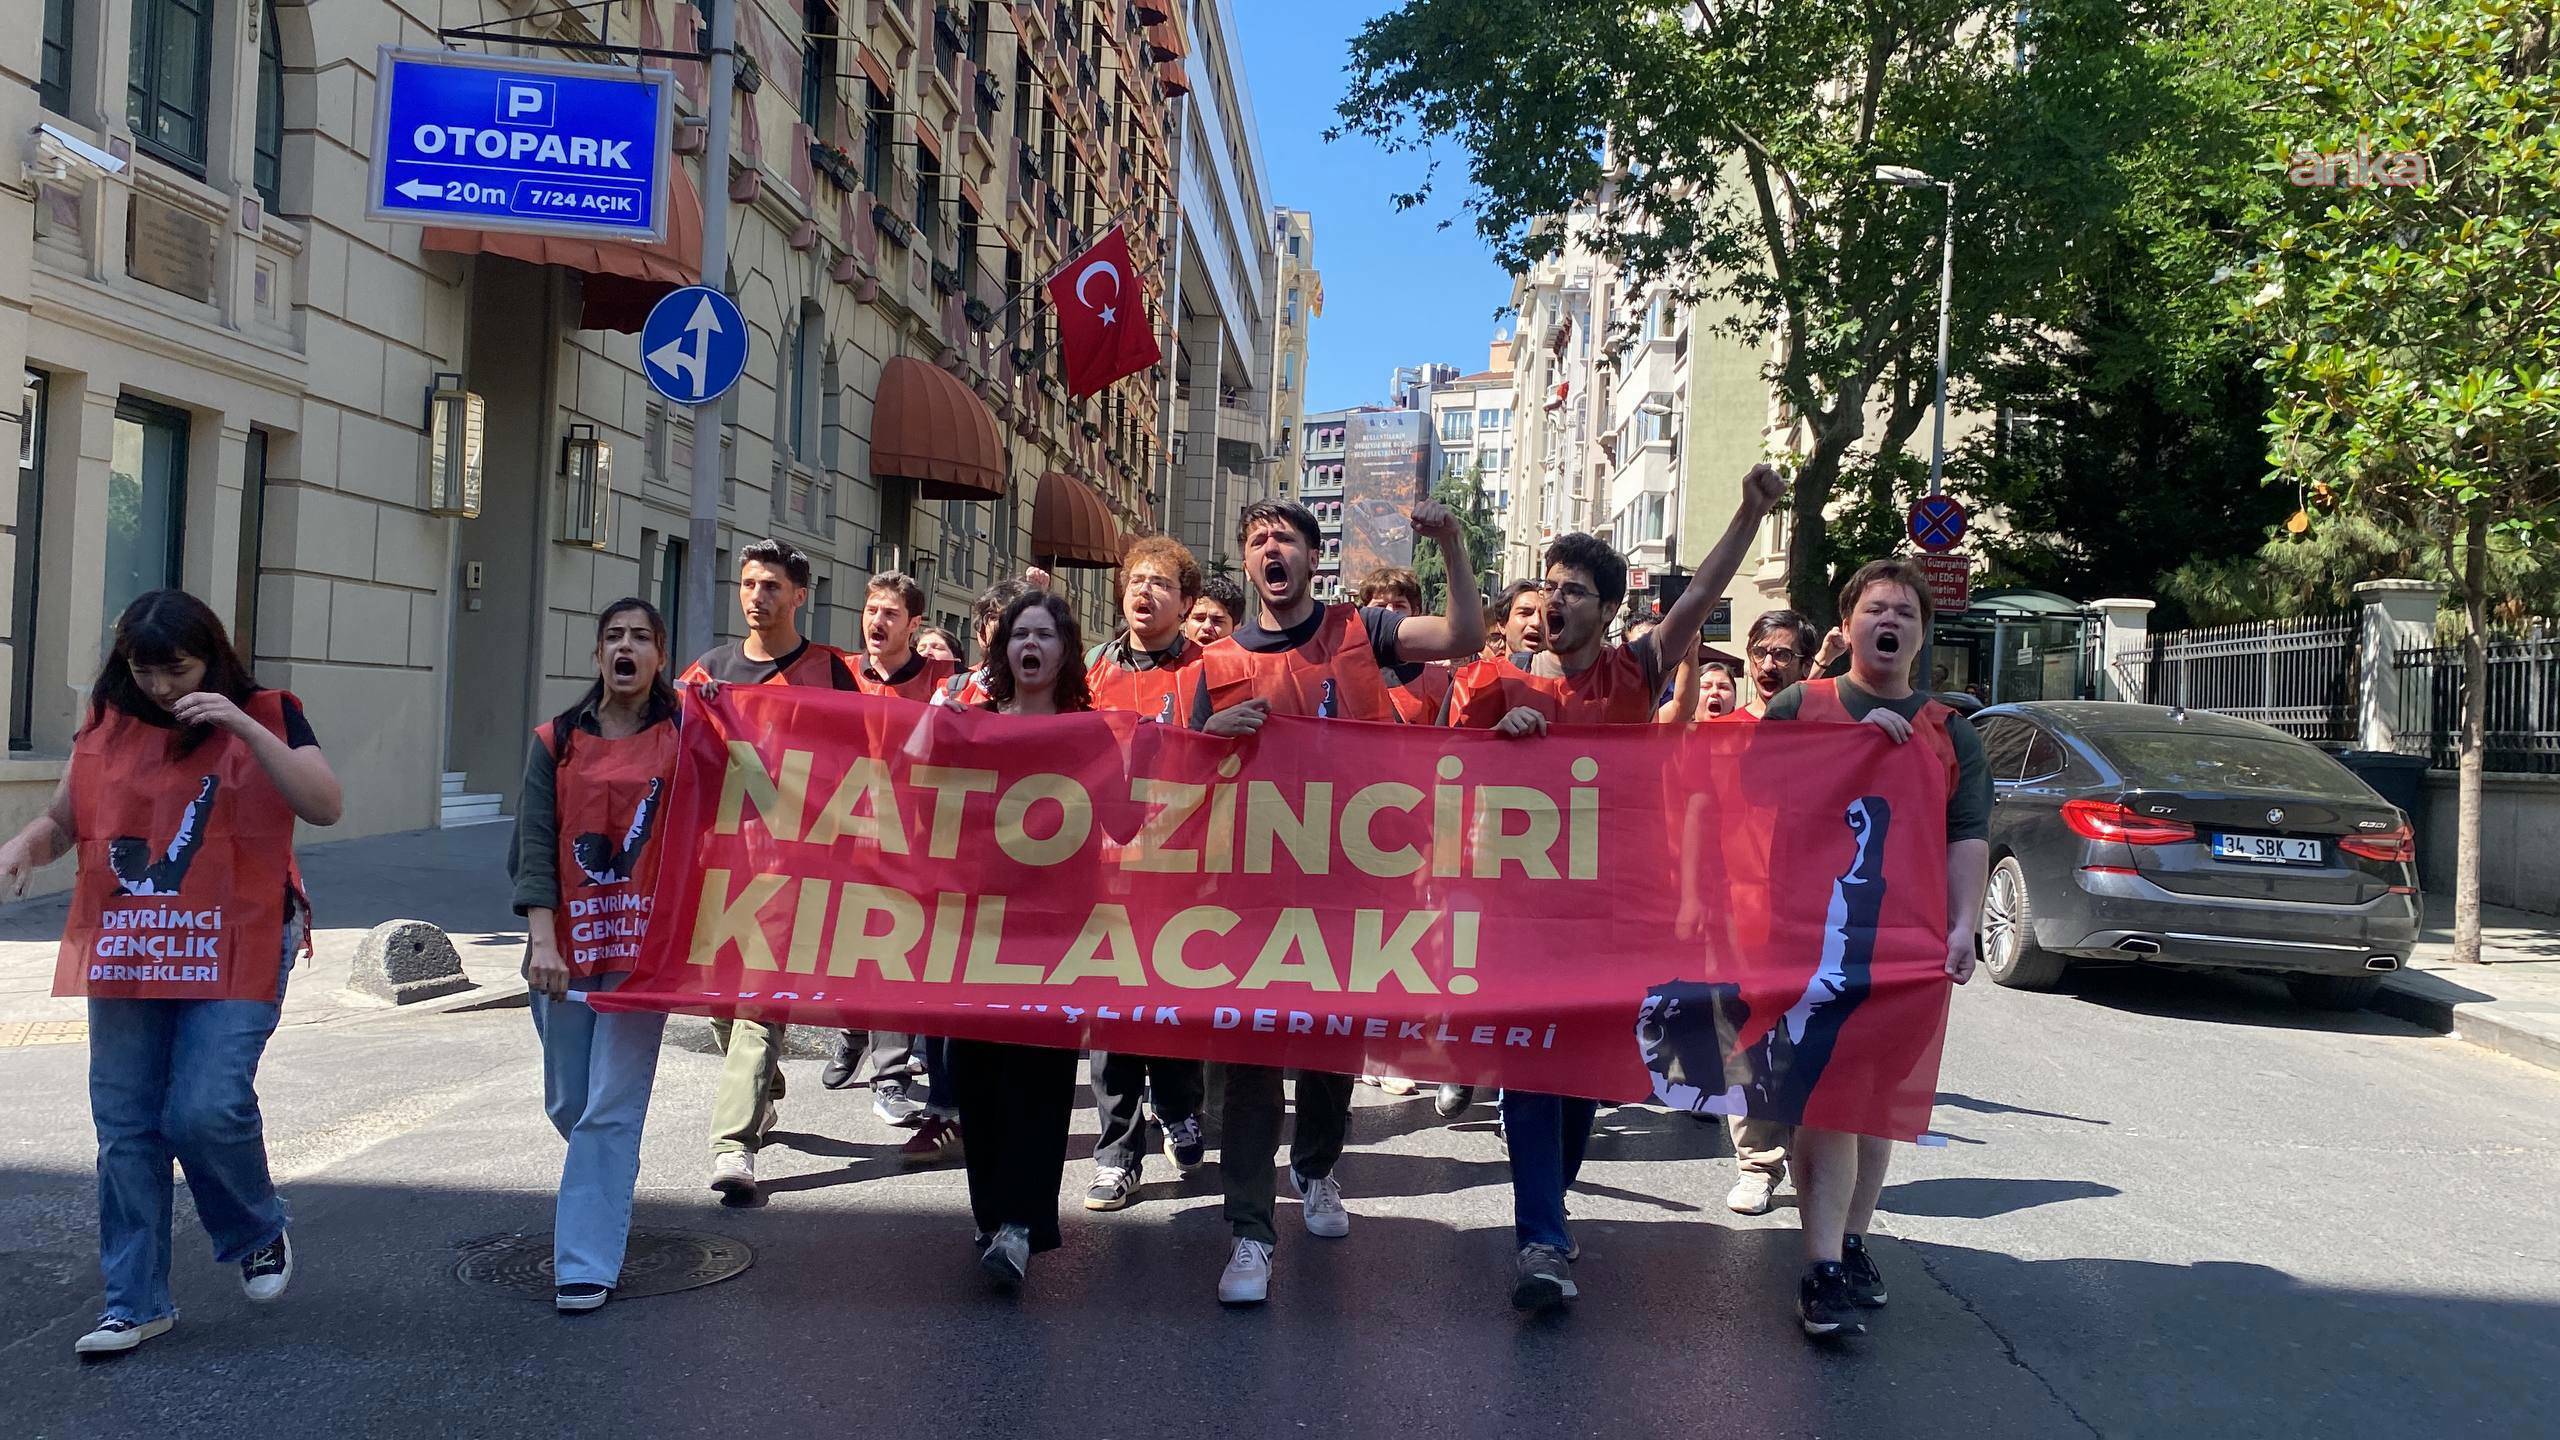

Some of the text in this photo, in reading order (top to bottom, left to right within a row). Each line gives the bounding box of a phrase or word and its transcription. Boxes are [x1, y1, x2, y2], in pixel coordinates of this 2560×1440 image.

[507, 86, 543, 118] P
[413, 124, 632, 170] OTOPARK
[445, 181, 633, 214] 20m 7/24 AÇIK
[1939, 572, 1954, 583] EDS
[713, 741, 1600, 881] NATO ZİNCİRİ
[2225, 836, 2245, 854] 34
[2256, 838, 2285, 857] SBK
[2297, 841, 2316, 859] 21
[102, 903, 222, 930] DEVRİMCİ
[687, 868, 1481, 996] KIRILACAK!
[96, 930, 219, 963] GENÇLİK
[89, 961, 219, 982] DERNEKLERİ
[1212, 1006, 1557, 1049] DERNEKLERİ
